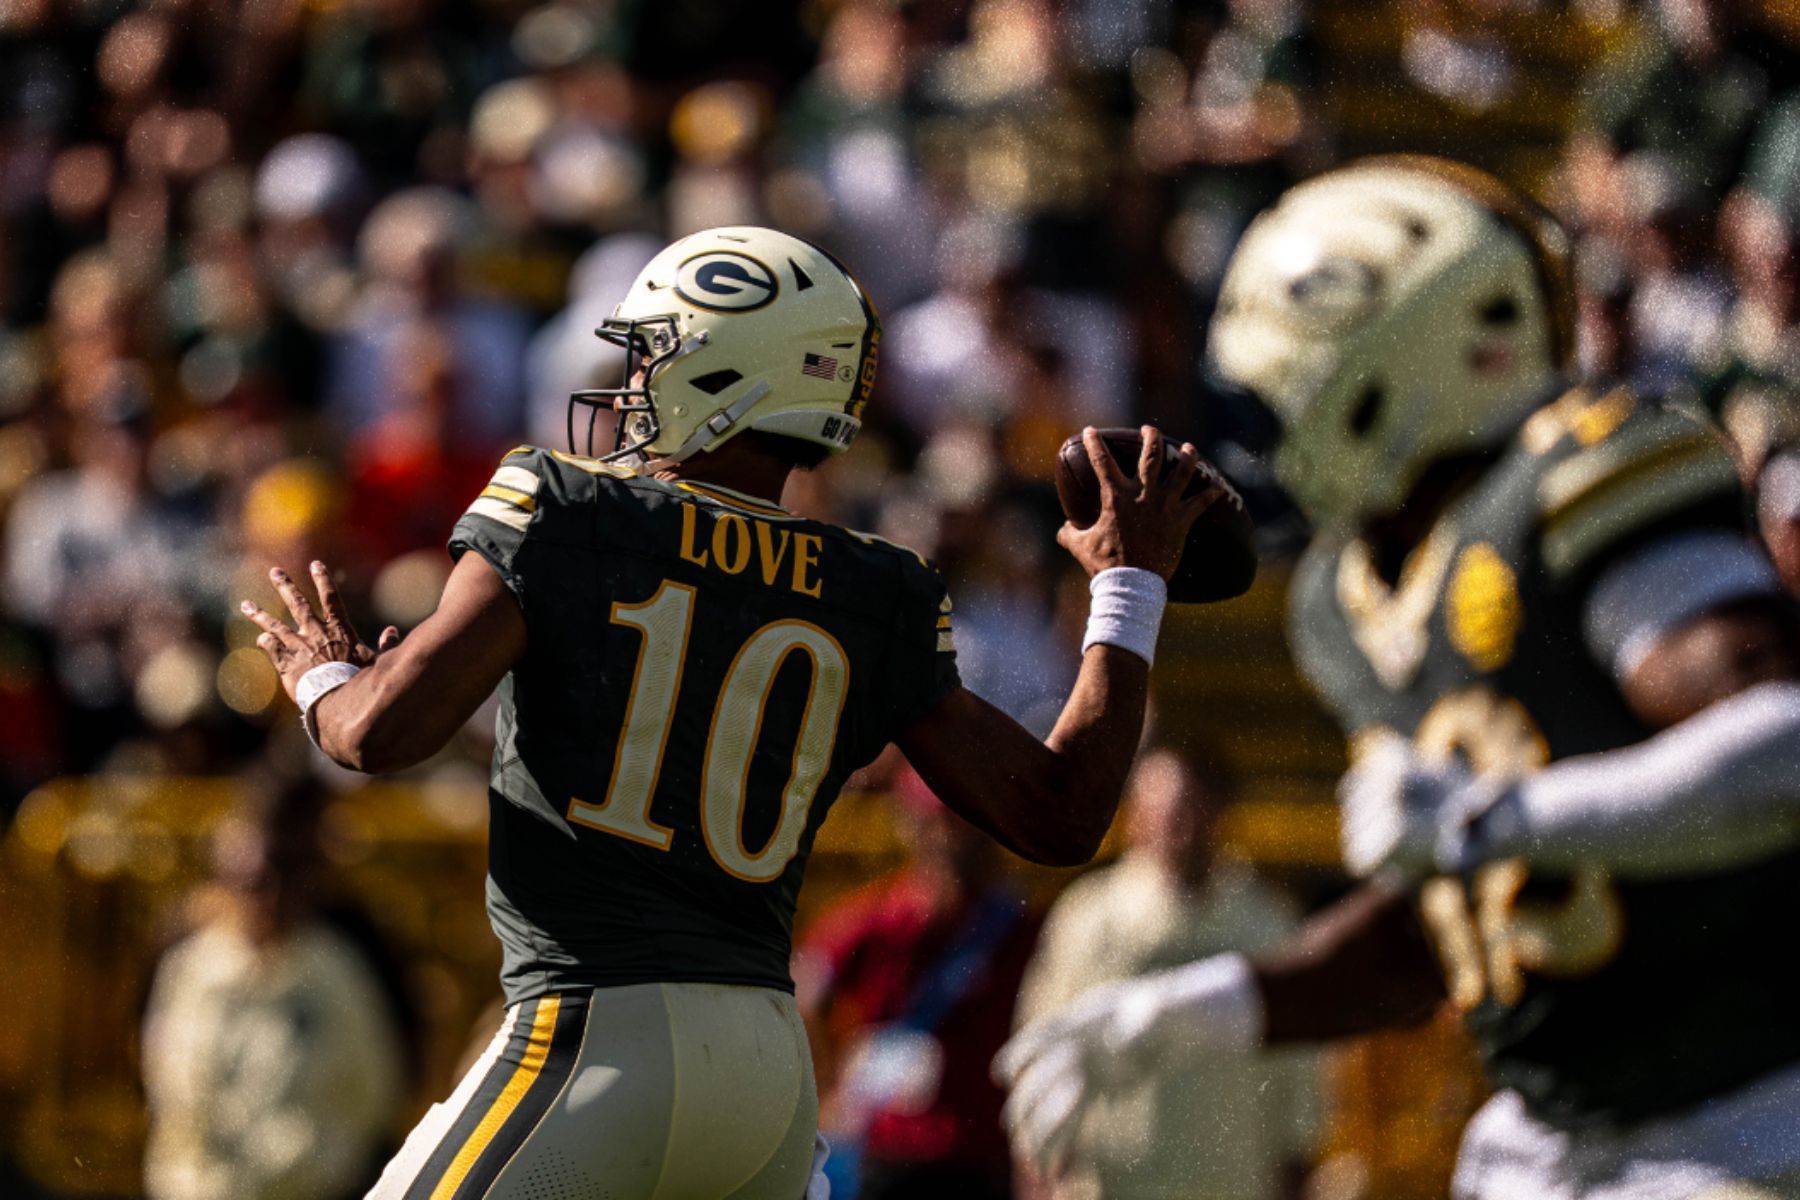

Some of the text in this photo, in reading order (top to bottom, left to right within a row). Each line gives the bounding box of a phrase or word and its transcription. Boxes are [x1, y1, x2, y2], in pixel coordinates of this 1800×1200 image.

[674, 251, 779, 314] G
[820, 417, 841, 439] GO
[680, 502, 823, 599] LOVE
[567, 579, 851, 883] 10
